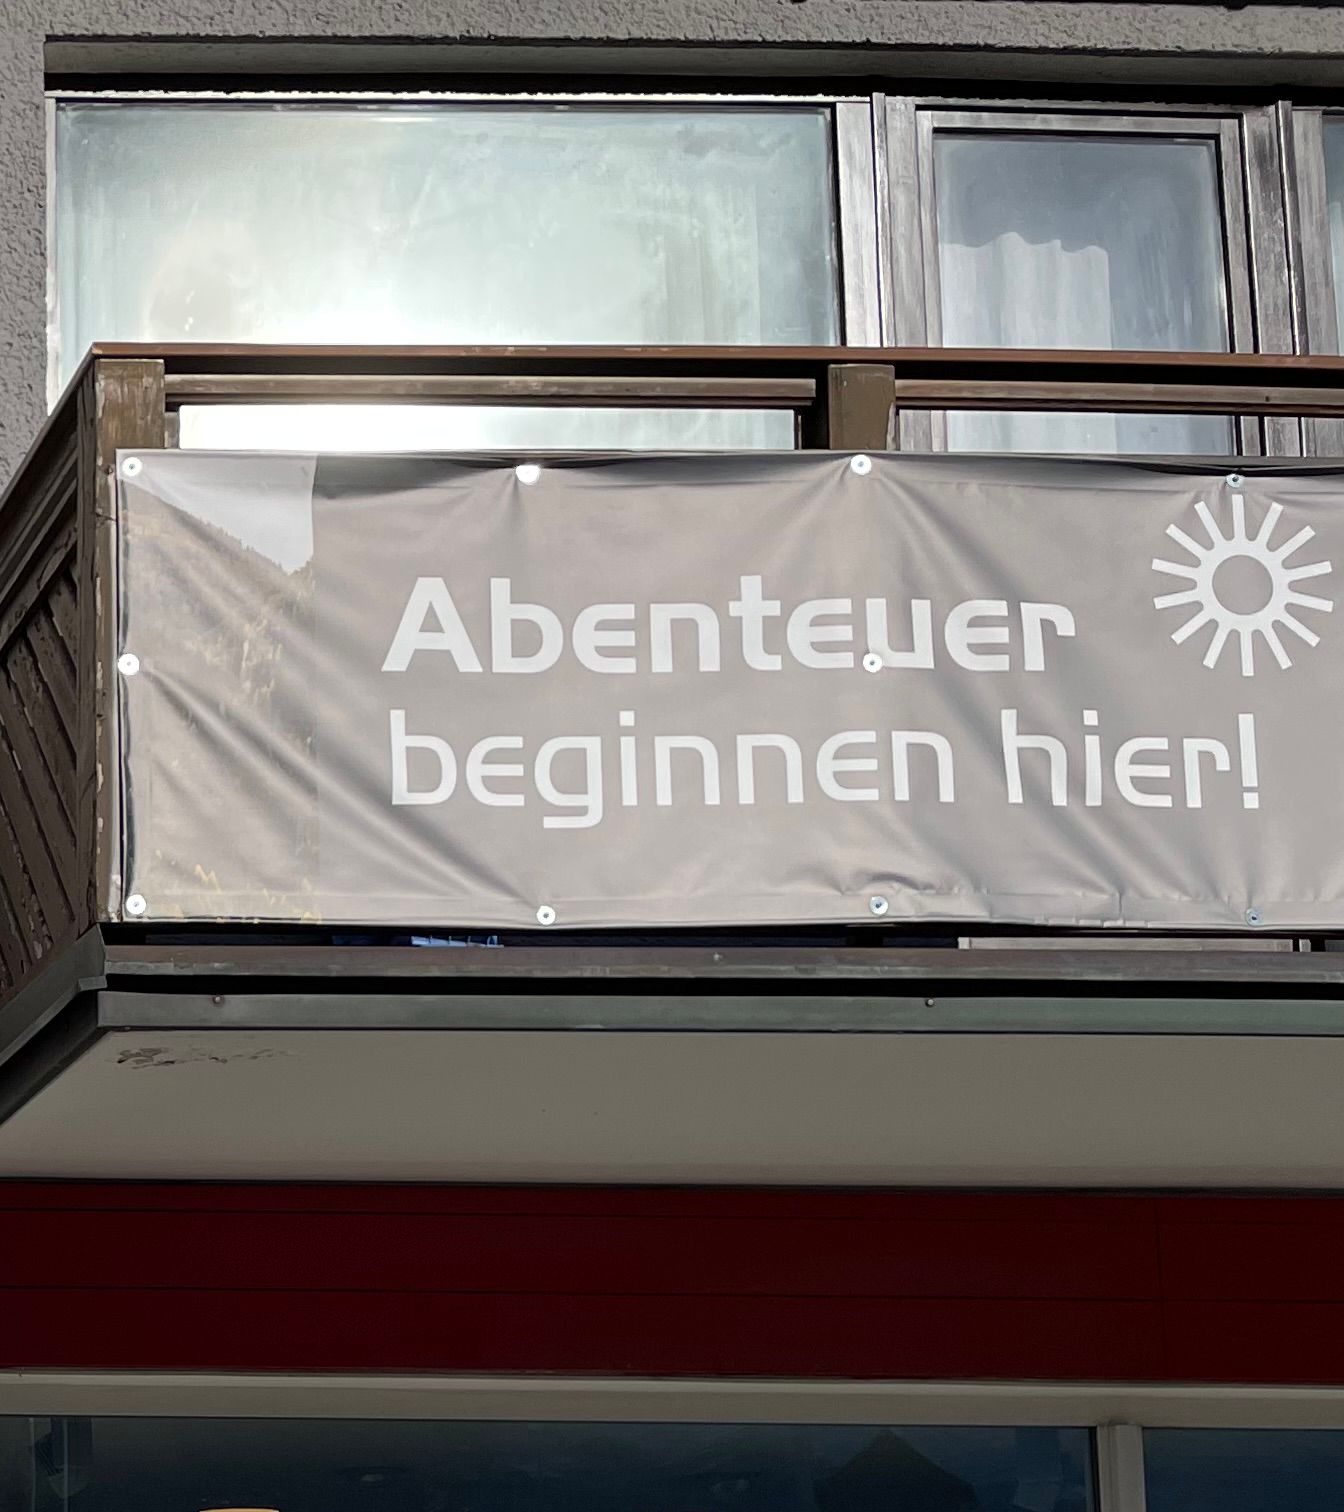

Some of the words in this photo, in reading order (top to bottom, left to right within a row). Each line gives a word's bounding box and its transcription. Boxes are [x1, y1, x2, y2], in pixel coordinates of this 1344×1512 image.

[381, 575, 1076, 674] Abenteuer
[388, 710, 954, 829] beginnen
[1001, 709, 1261, 809] hier!
